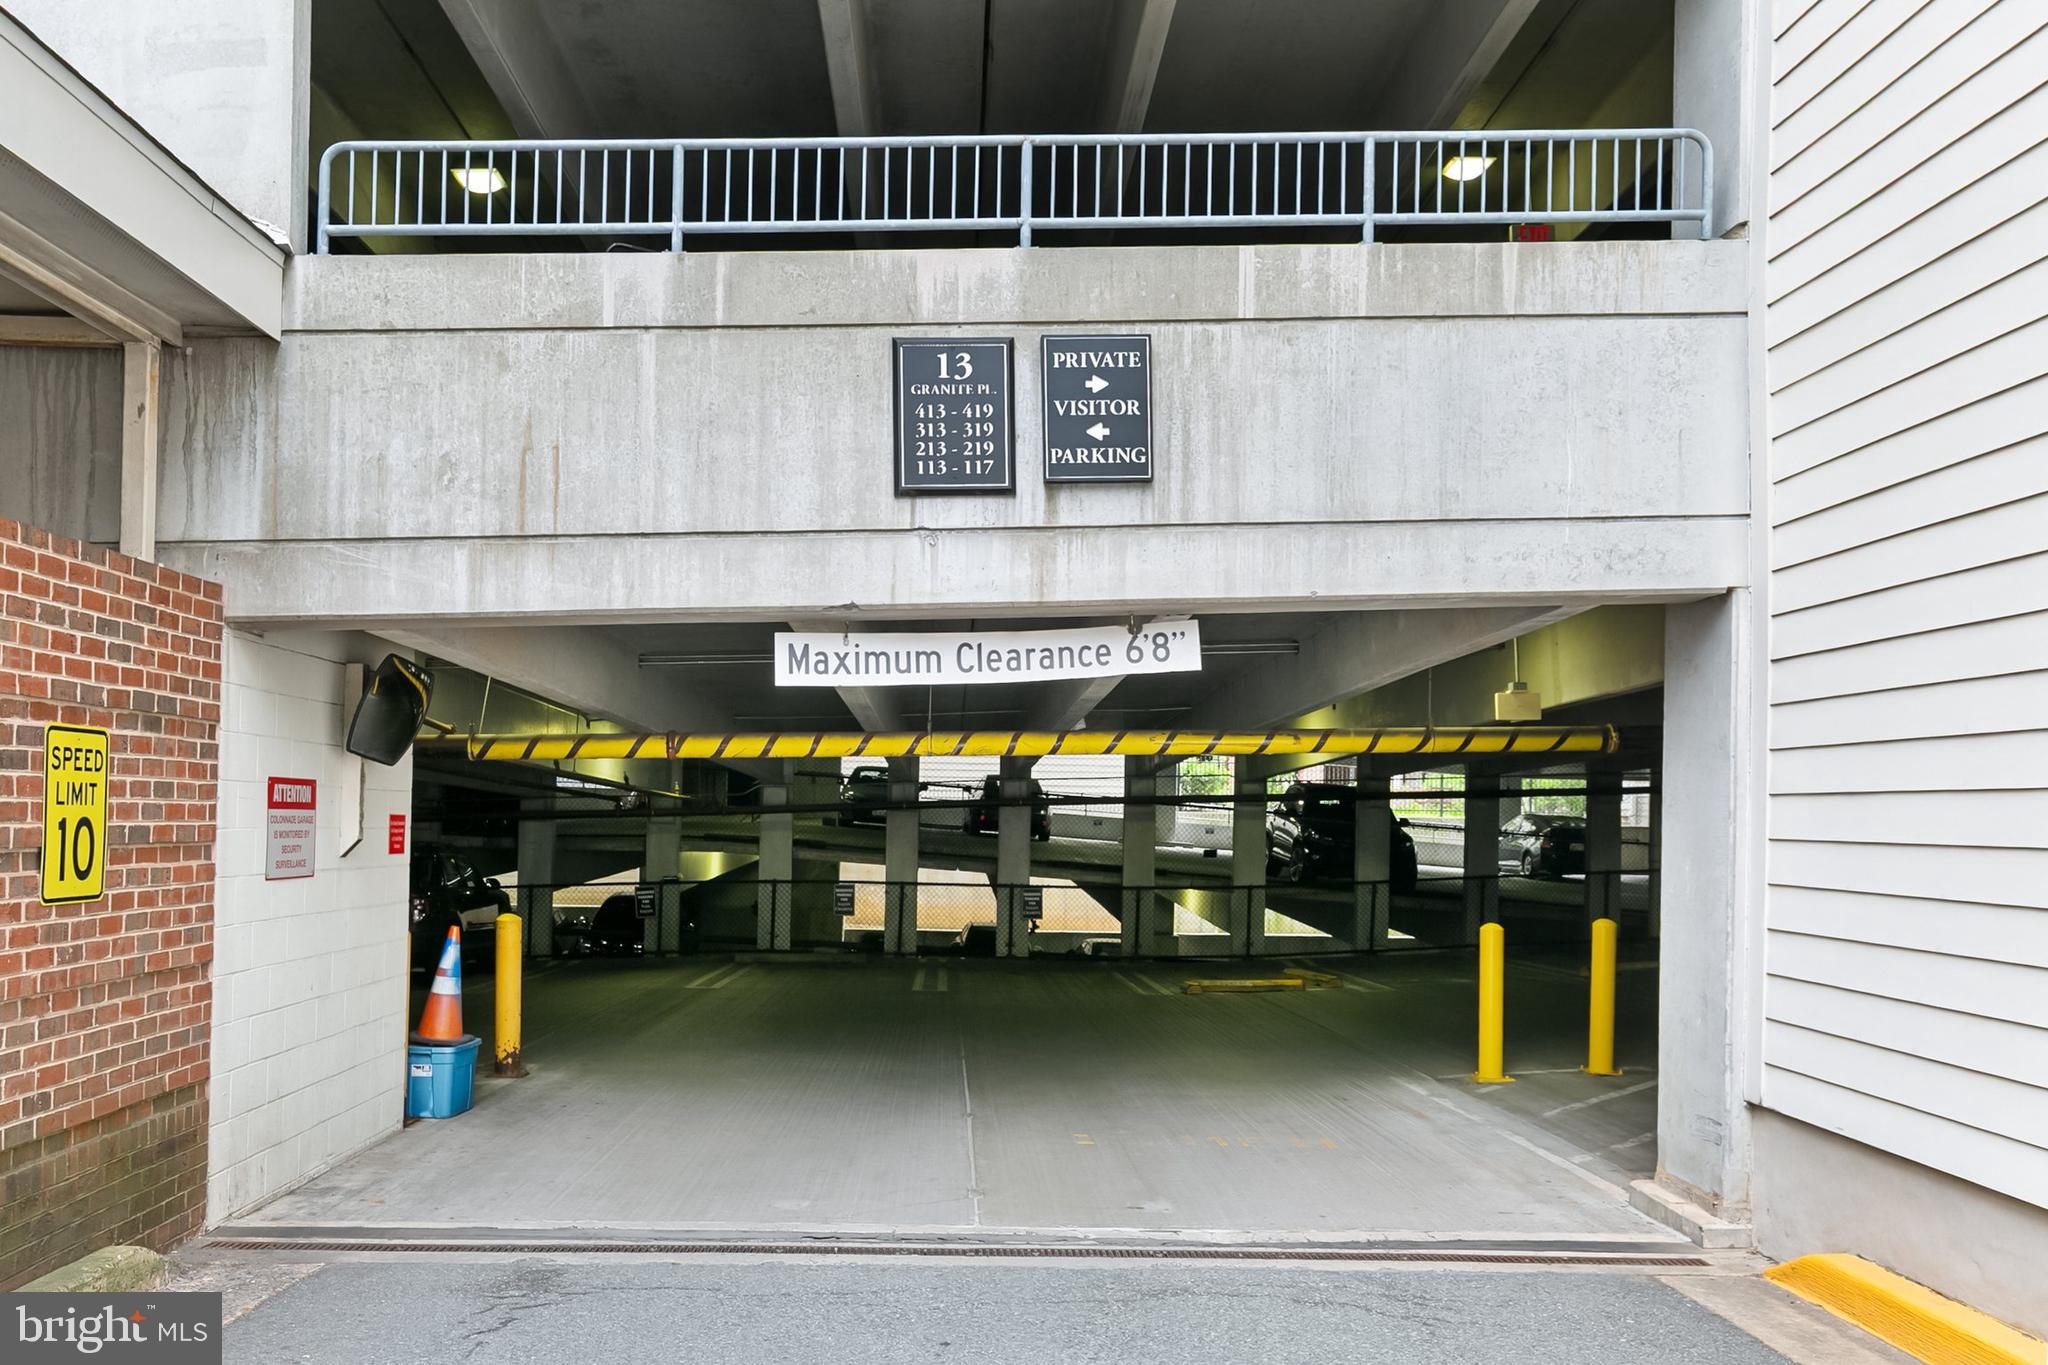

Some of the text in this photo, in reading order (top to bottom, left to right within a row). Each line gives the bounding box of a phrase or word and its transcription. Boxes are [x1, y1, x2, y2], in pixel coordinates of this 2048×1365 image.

[937, 352, 974, 381] 13
[1053, 352, 1141, 368] PRIVATE
[910, 384, 997, 396] GRANITE PL.
[915, 403, 946, 419] 413
[962, 403, 994, 419] 419
[1054, 400, 1141, 416] VISITOR
[915, 422, 947, 438] 313
[962, 422, 994, 438] 319
[915, 441, 947, 457] 213
[963, 441, 994, 457] 219
[1050, 447, 1147, 464] PARKING
[917, 460, 947, 475] 113
[964, 460, 994, 475] 117
[787, 642, 943, 675] Maximum
[956, 641, 1112, 673] Clearance
[51, 746, 104, 772] SPEED
[56, 781, 98, 806] LIMIT
[273, 784, 312, 803] ATTENTION
[270, 815, 296, 824] COLONNADE
[279, 829, 303, 839] MONITORED
[58, 816, 95, 882] 10
[281, 844, 302, 854] SECURITY
[275, 859, 307, 869] SURVEILLANCE
